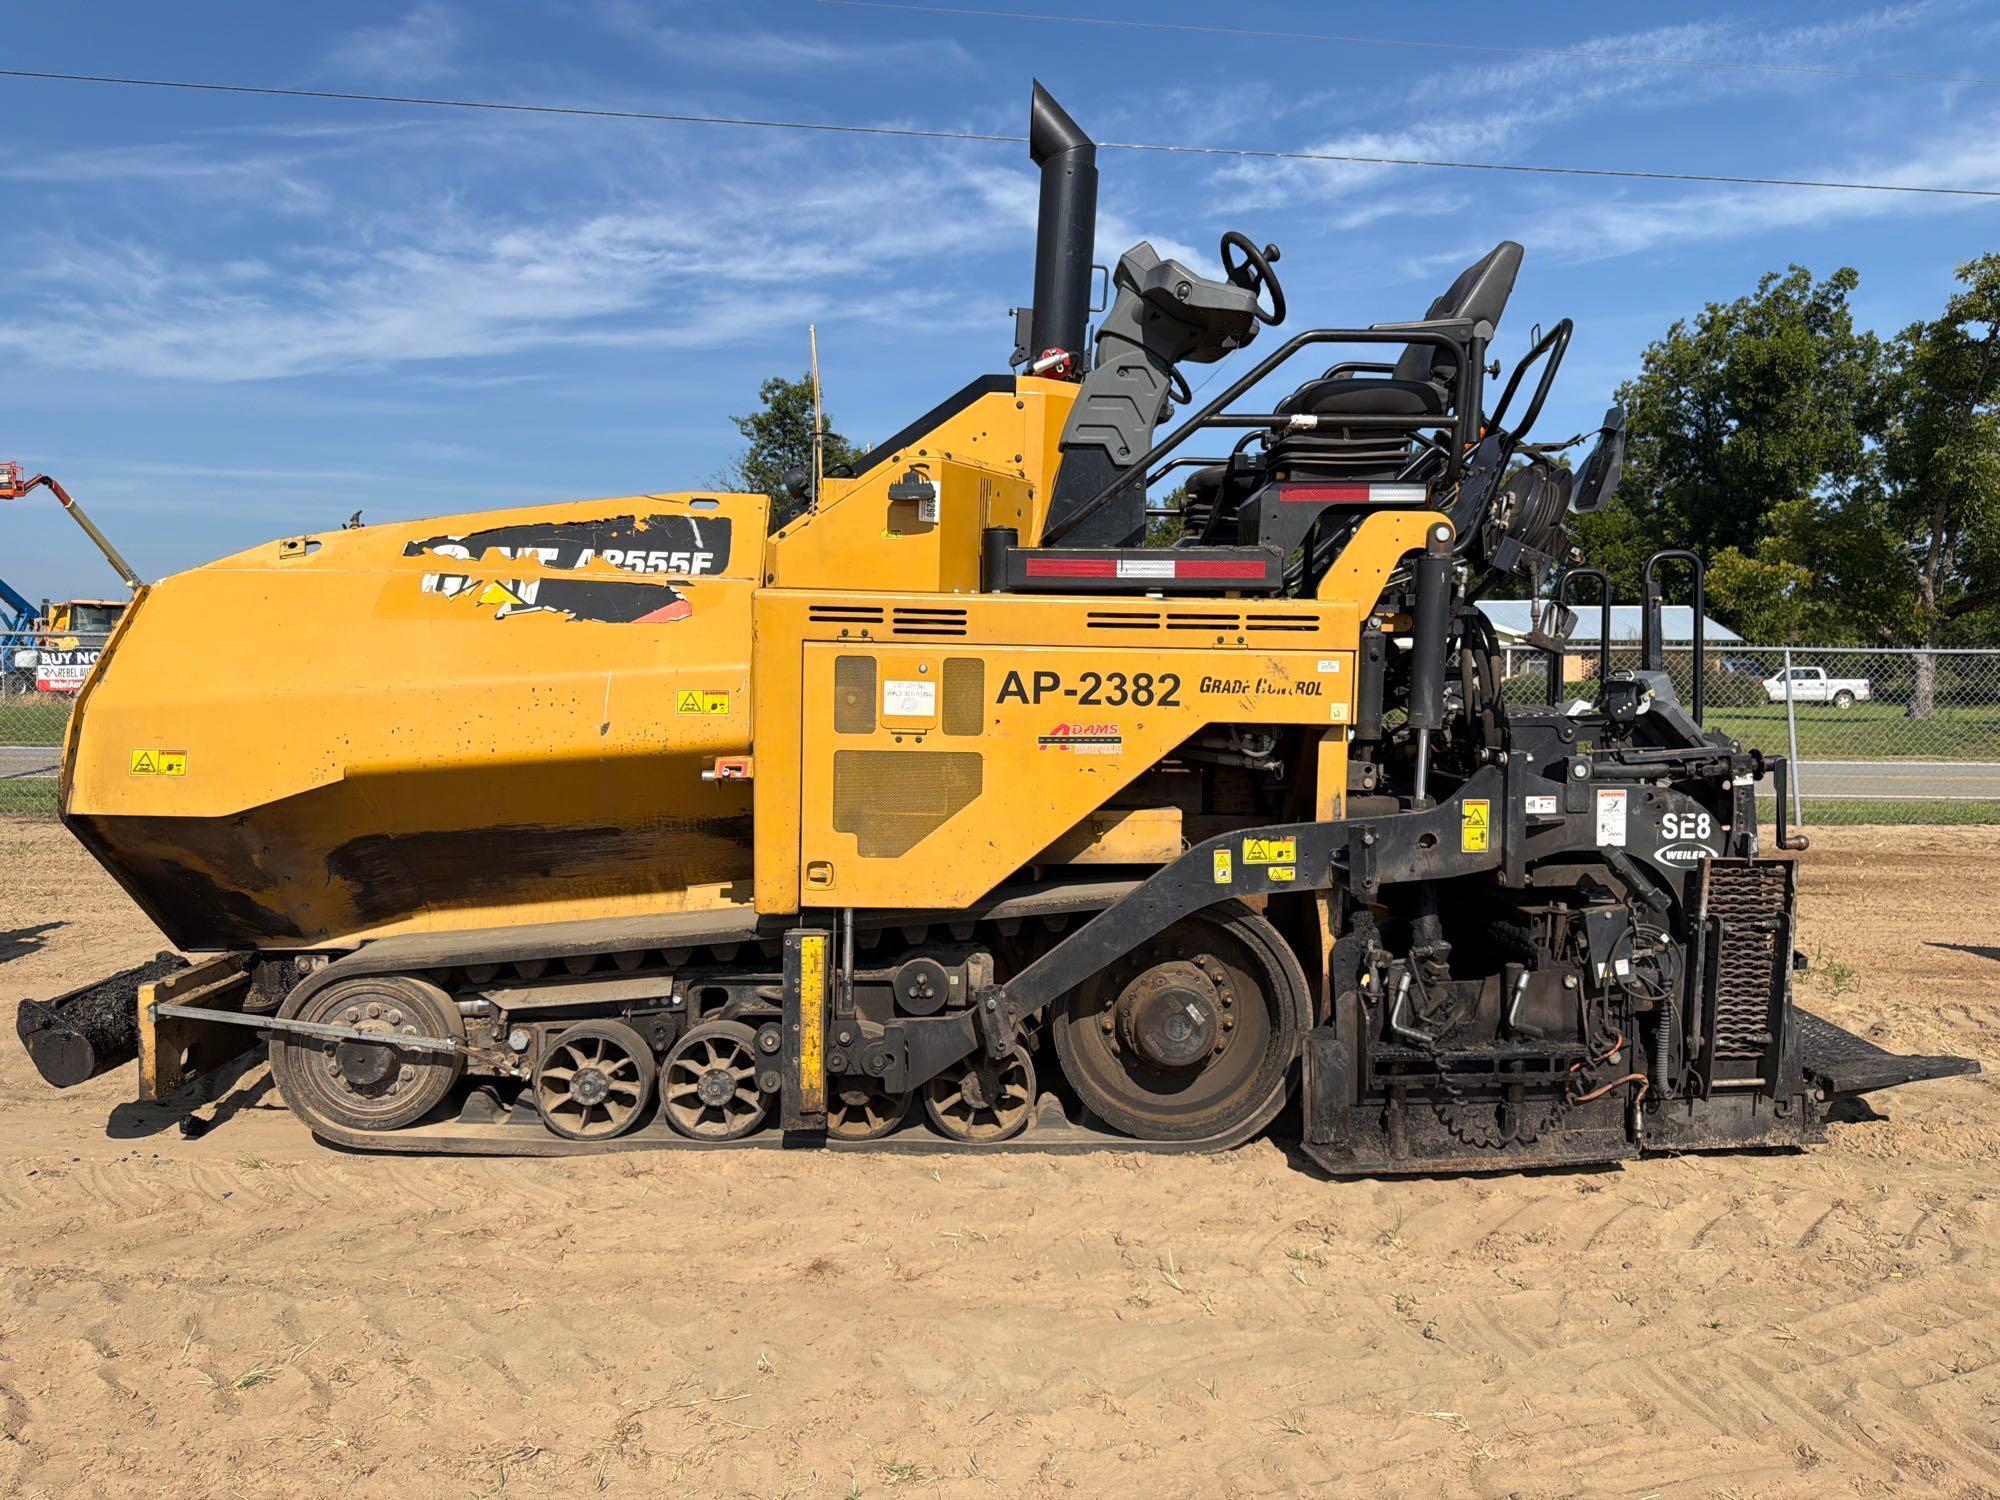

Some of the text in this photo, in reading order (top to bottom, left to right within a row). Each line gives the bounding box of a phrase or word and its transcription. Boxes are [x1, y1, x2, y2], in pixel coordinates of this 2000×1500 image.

[41, 651, 73, 664] BUY
[57, 667, 78, 678] REBEL
[995, 670, 1181, 707] AP-2382
[1661, 813, 1711, 839] SE8
[1666, 850, 1707, 860] WEILER
